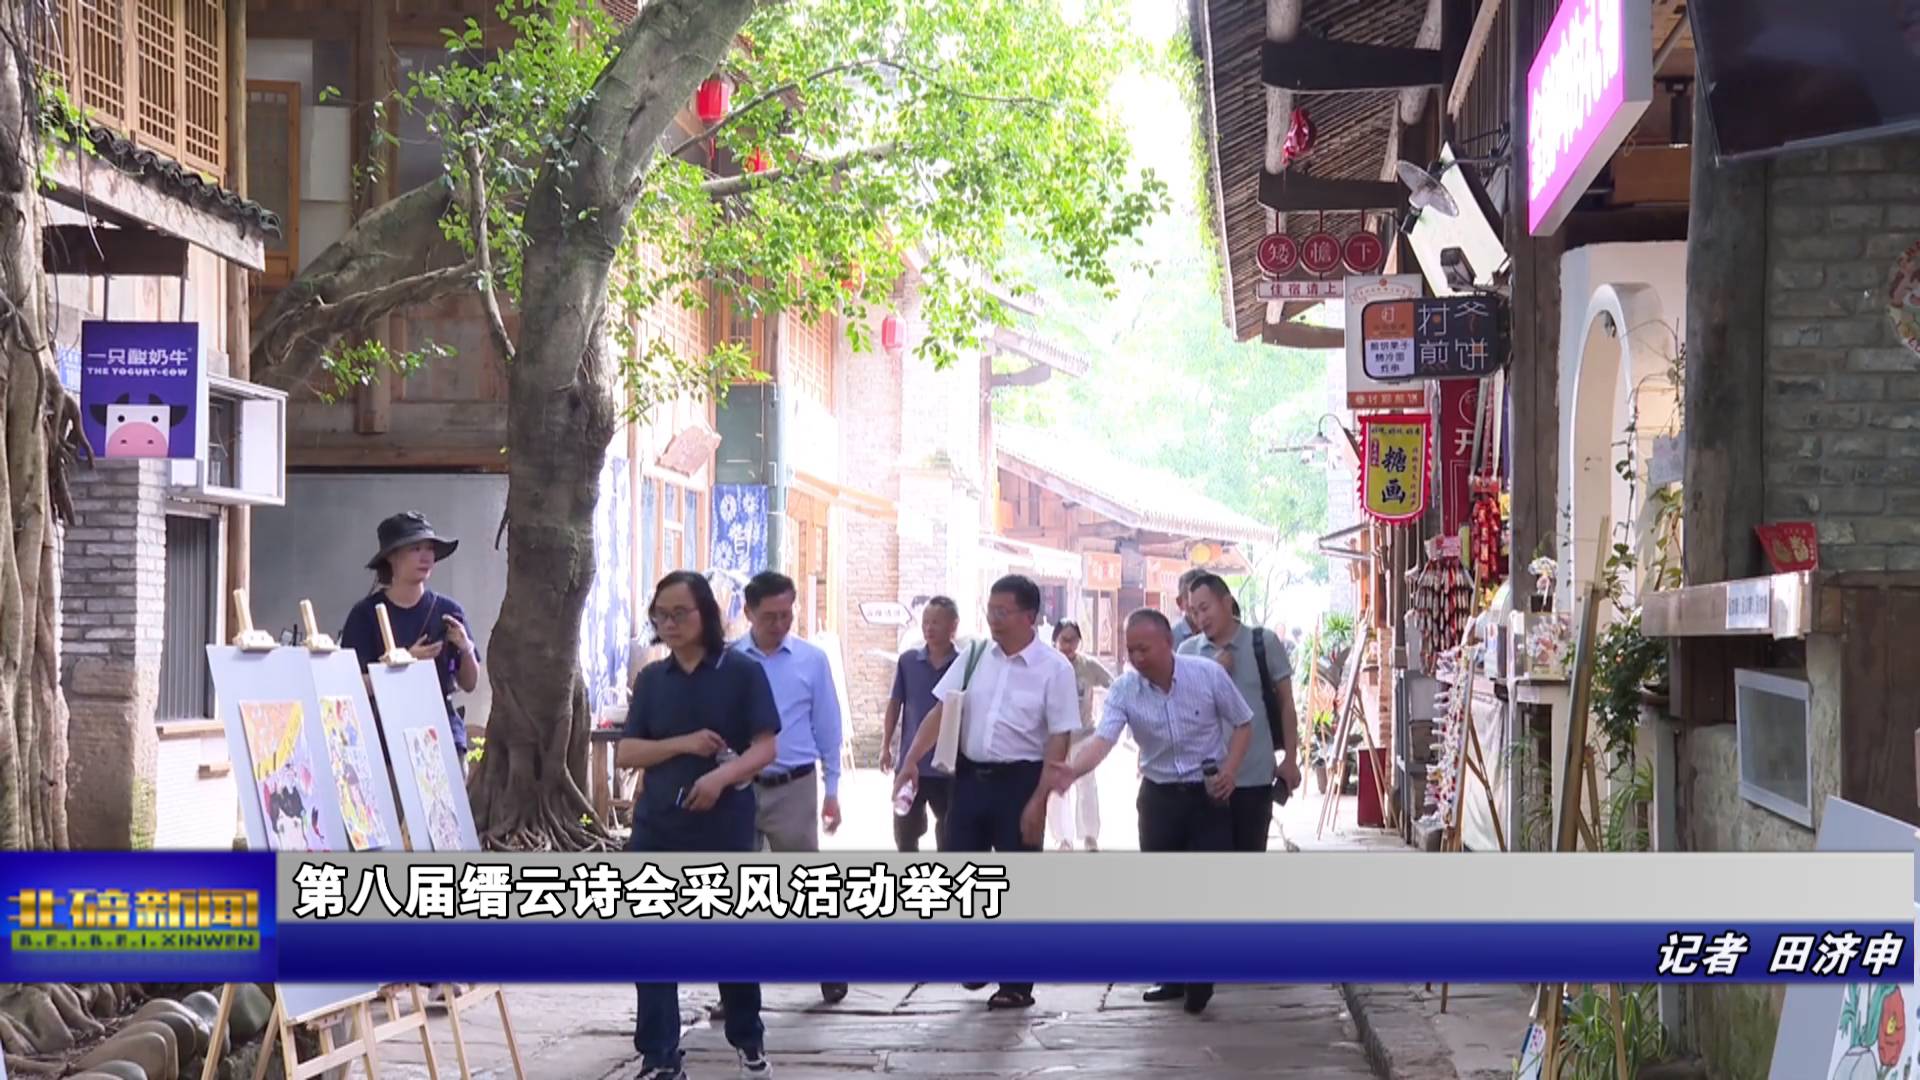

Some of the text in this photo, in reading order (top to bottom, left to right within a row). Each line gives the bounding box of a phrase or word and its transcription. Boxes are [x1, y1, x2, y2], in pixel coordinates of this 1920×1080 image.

[87, 347, 189, 366] 一只酸奶牛
[87, 367, 188, 376] THE YOGURT-COW
[1381, 445, 1407, 504] 糖画
